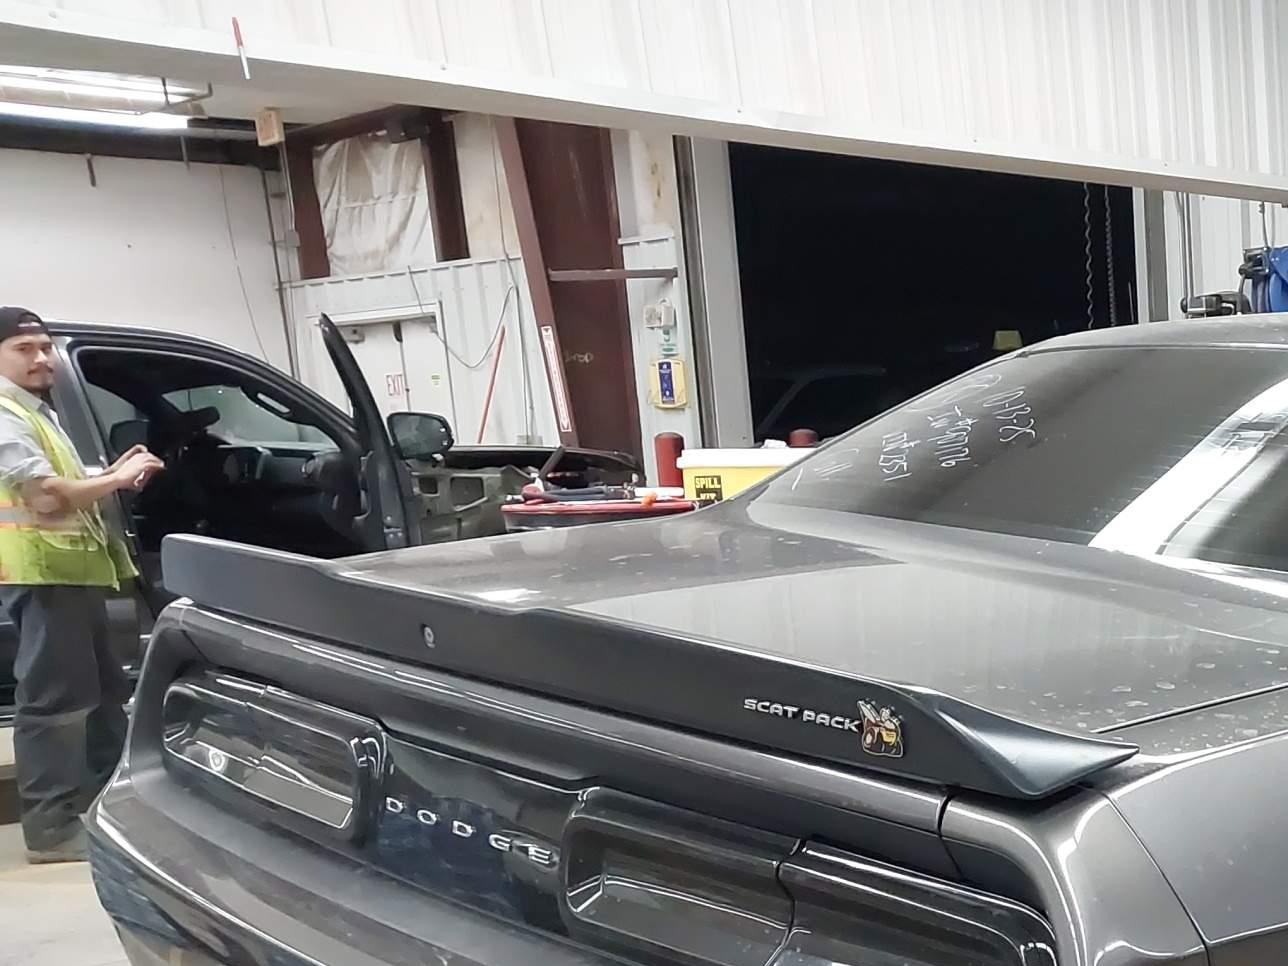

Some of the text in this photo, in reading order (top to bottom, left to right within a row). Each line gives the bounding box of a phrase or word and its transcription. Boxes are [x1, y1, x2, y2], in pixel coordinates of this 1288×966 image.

[385, 373, 405, 397] EXIT
[695, 476, 721, 489] SPILL
[743, 698, 862, 734] SCAT PACK
[385, 796, 553, 865] DODGE
